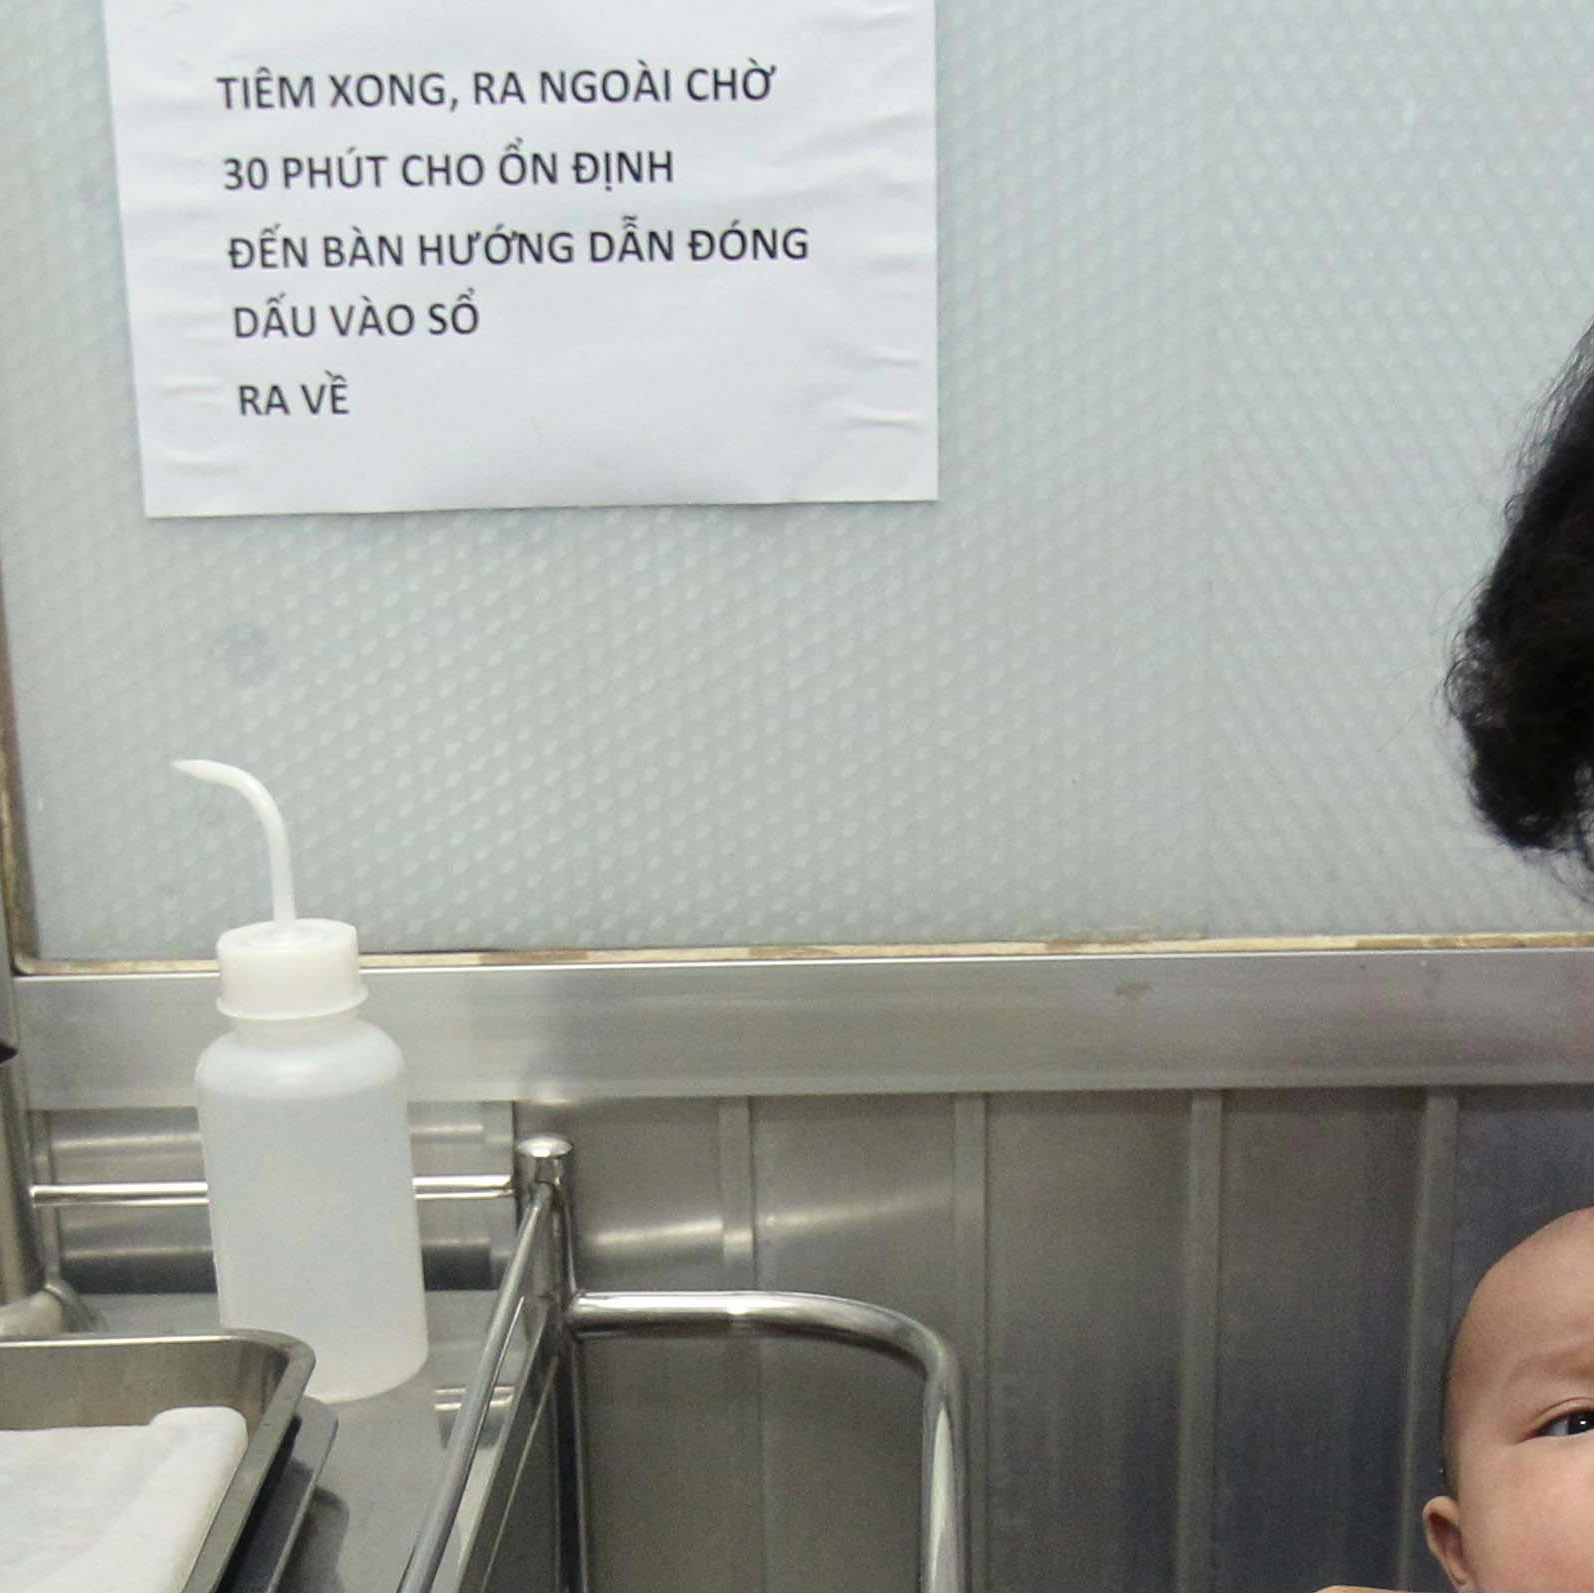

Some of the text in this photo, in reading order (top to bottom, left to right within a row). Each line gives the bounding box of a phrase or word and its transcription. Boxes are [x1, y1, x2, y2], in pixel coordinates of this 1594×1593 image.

[215, 56, 778, 113] TIÊM XONG, RA NGOÀI CHỜ
[222, 136, 674, 193] 30 PHÚT CHO ỔN ĐỊNH
[227, 214, 809, 270] ĐẾN BÀN HƯỚNG DẪN ĐÓNG
[232, 287, 480, 339] DẤU VÀO SỔ
[237, 369, 350, 417] RA VỀ
